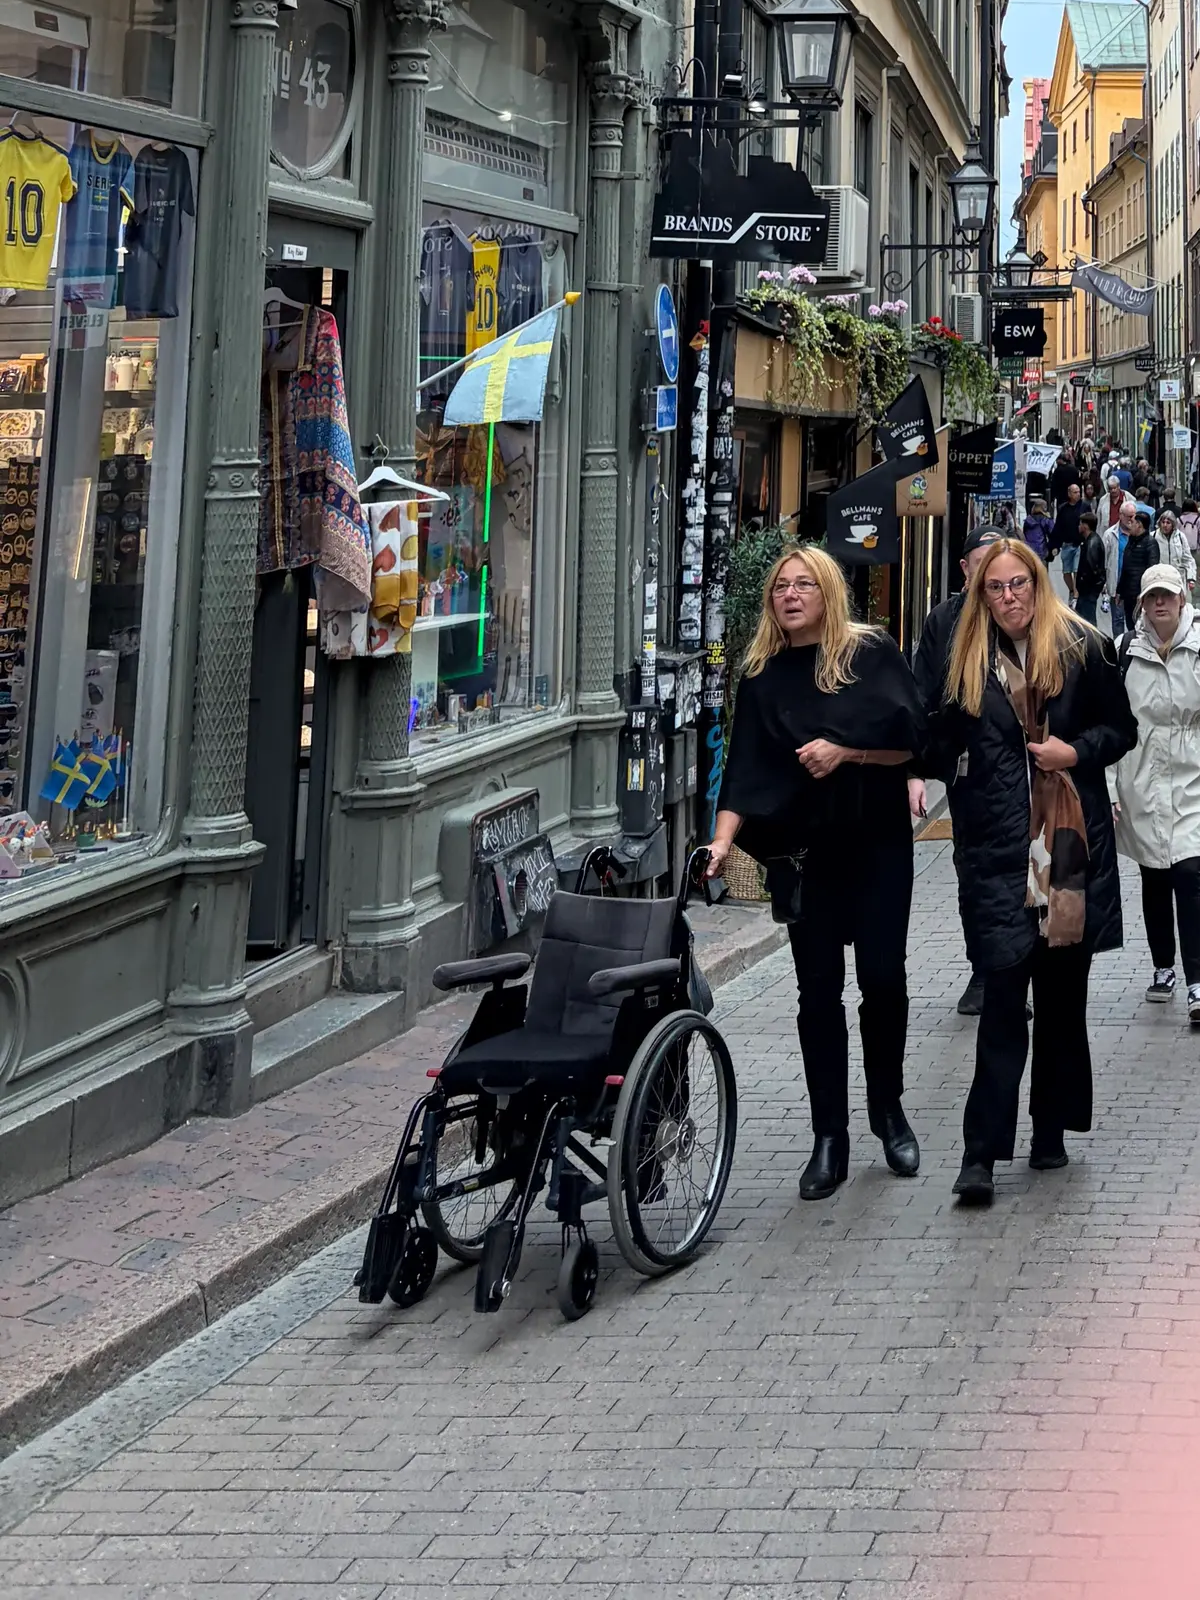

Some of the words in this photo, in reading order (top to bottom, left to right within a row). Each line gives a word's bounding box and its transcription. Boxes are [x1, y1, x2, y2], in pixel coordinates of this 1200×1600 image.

[299, 57, 331, 109] 43
[5, 176, 46, 247] 10
[663, 214, 733, 233] BRANDS
[755, 224, 812, 242] STORE
[476, 286, 495, 332] 10
[1004, 325, 1036, 338] E&W
[891, 419, 925, 438] BELLMANS
[902, 429, 918, 439] CAFE
[949, 449, 992, 465] ÖPPET
[841, 505, 884, 518] BELLMANS
[853, 514, 872, 522] CAFE
